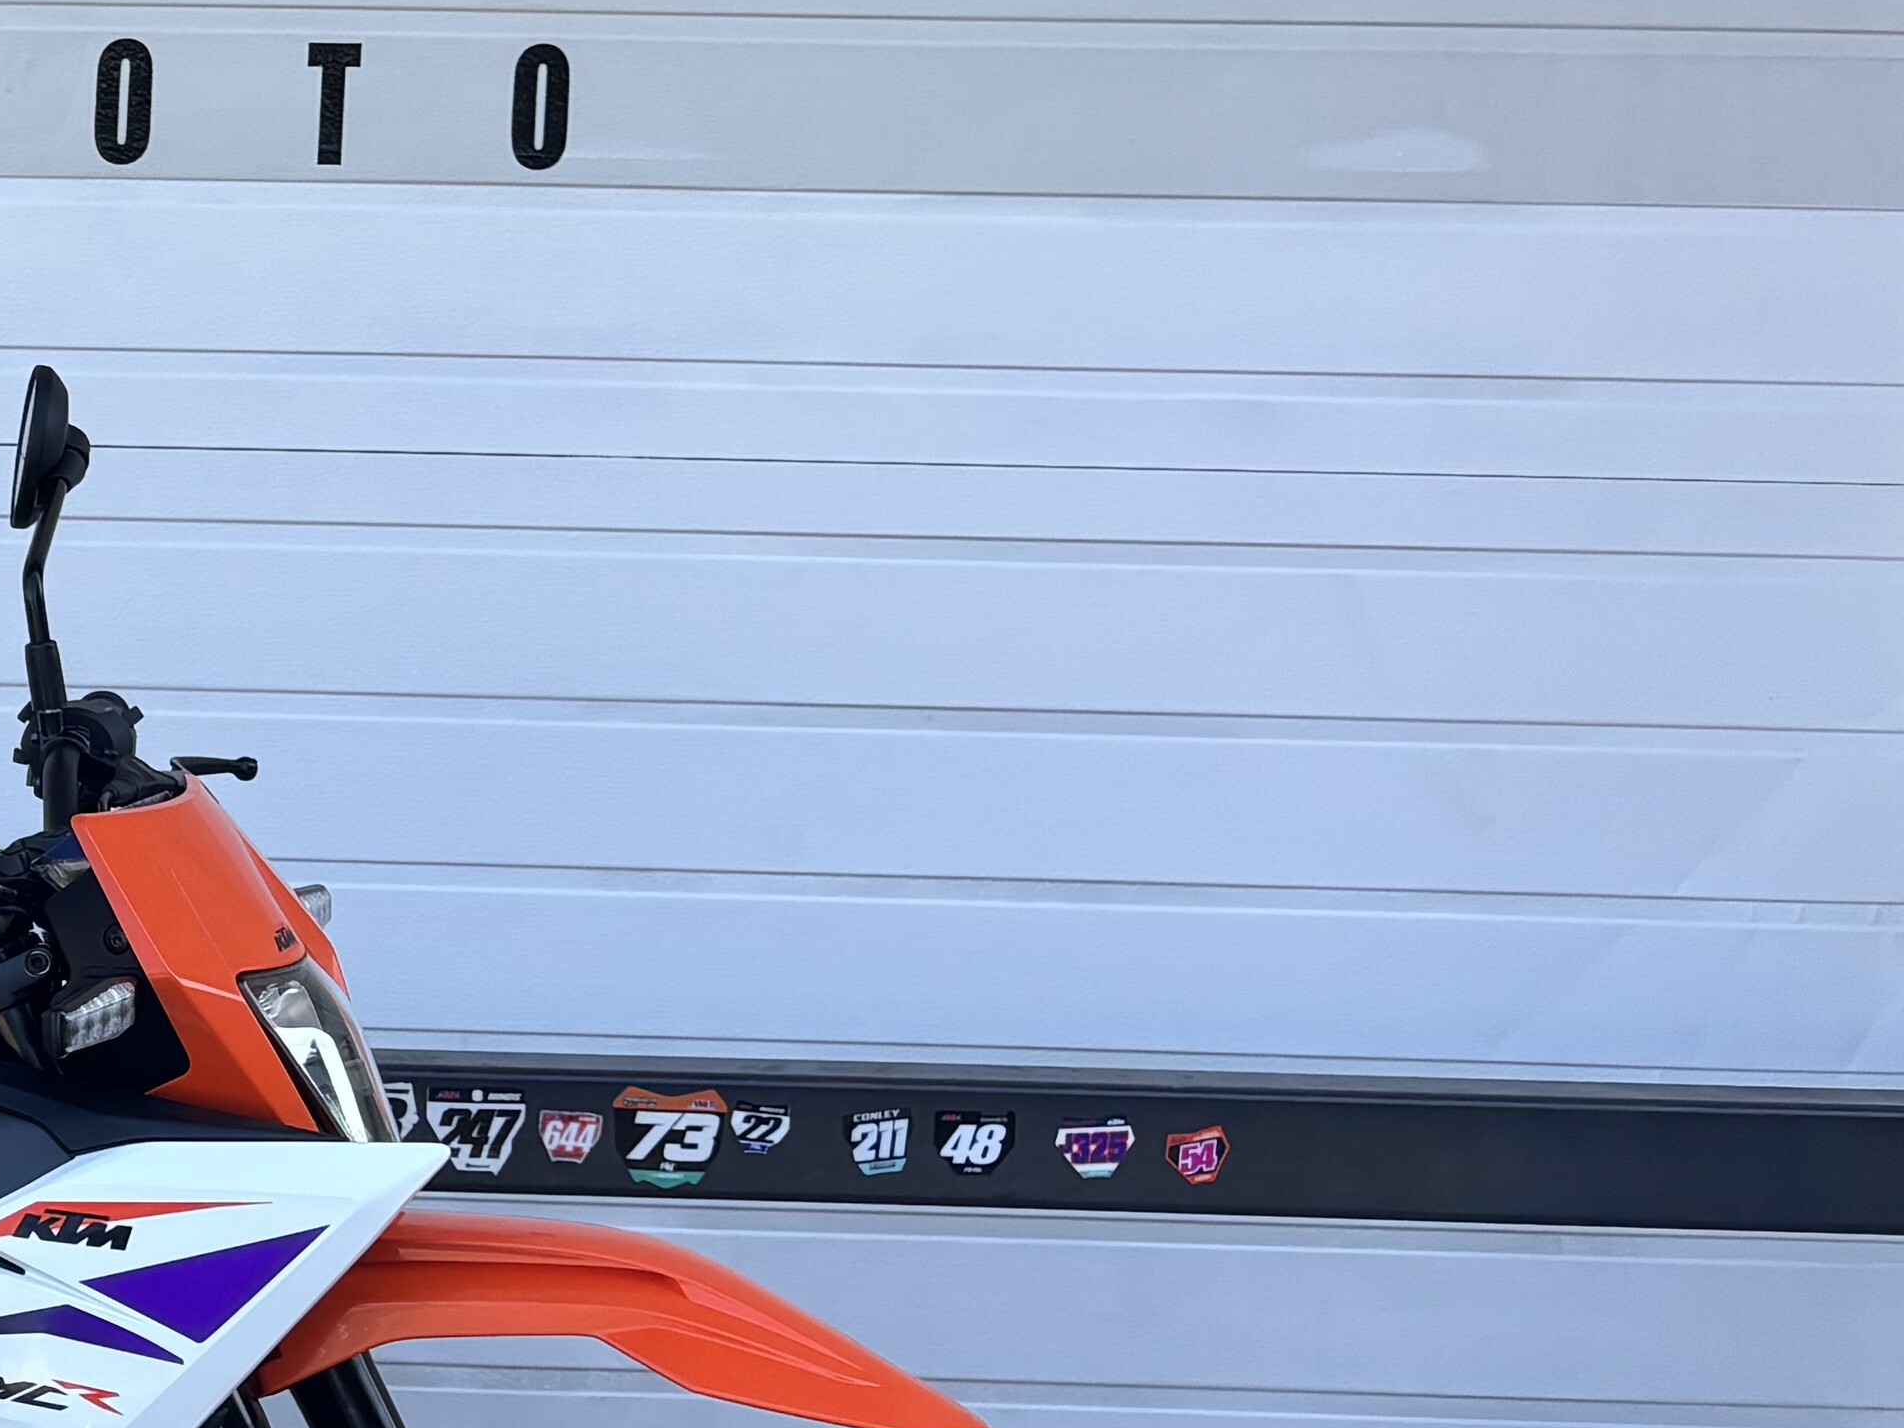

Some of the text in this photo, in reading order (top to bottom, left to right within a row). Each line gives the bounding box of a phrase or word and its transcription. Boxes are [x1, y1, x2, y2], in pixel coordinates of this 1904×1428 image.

[438, 1108, 522, 1159] 247
[543, 1119, 597, 1152] 644
[626, 1110, 721, 1162] 73
[738, 1114, 783, 1144] 22
[850, 1118, 910, 1162] 211
[940, 1123, 1007, 1165] 48
[1179, 1139, 1218, 1176] 54
[12, 1208, 133, 1251] KTM
